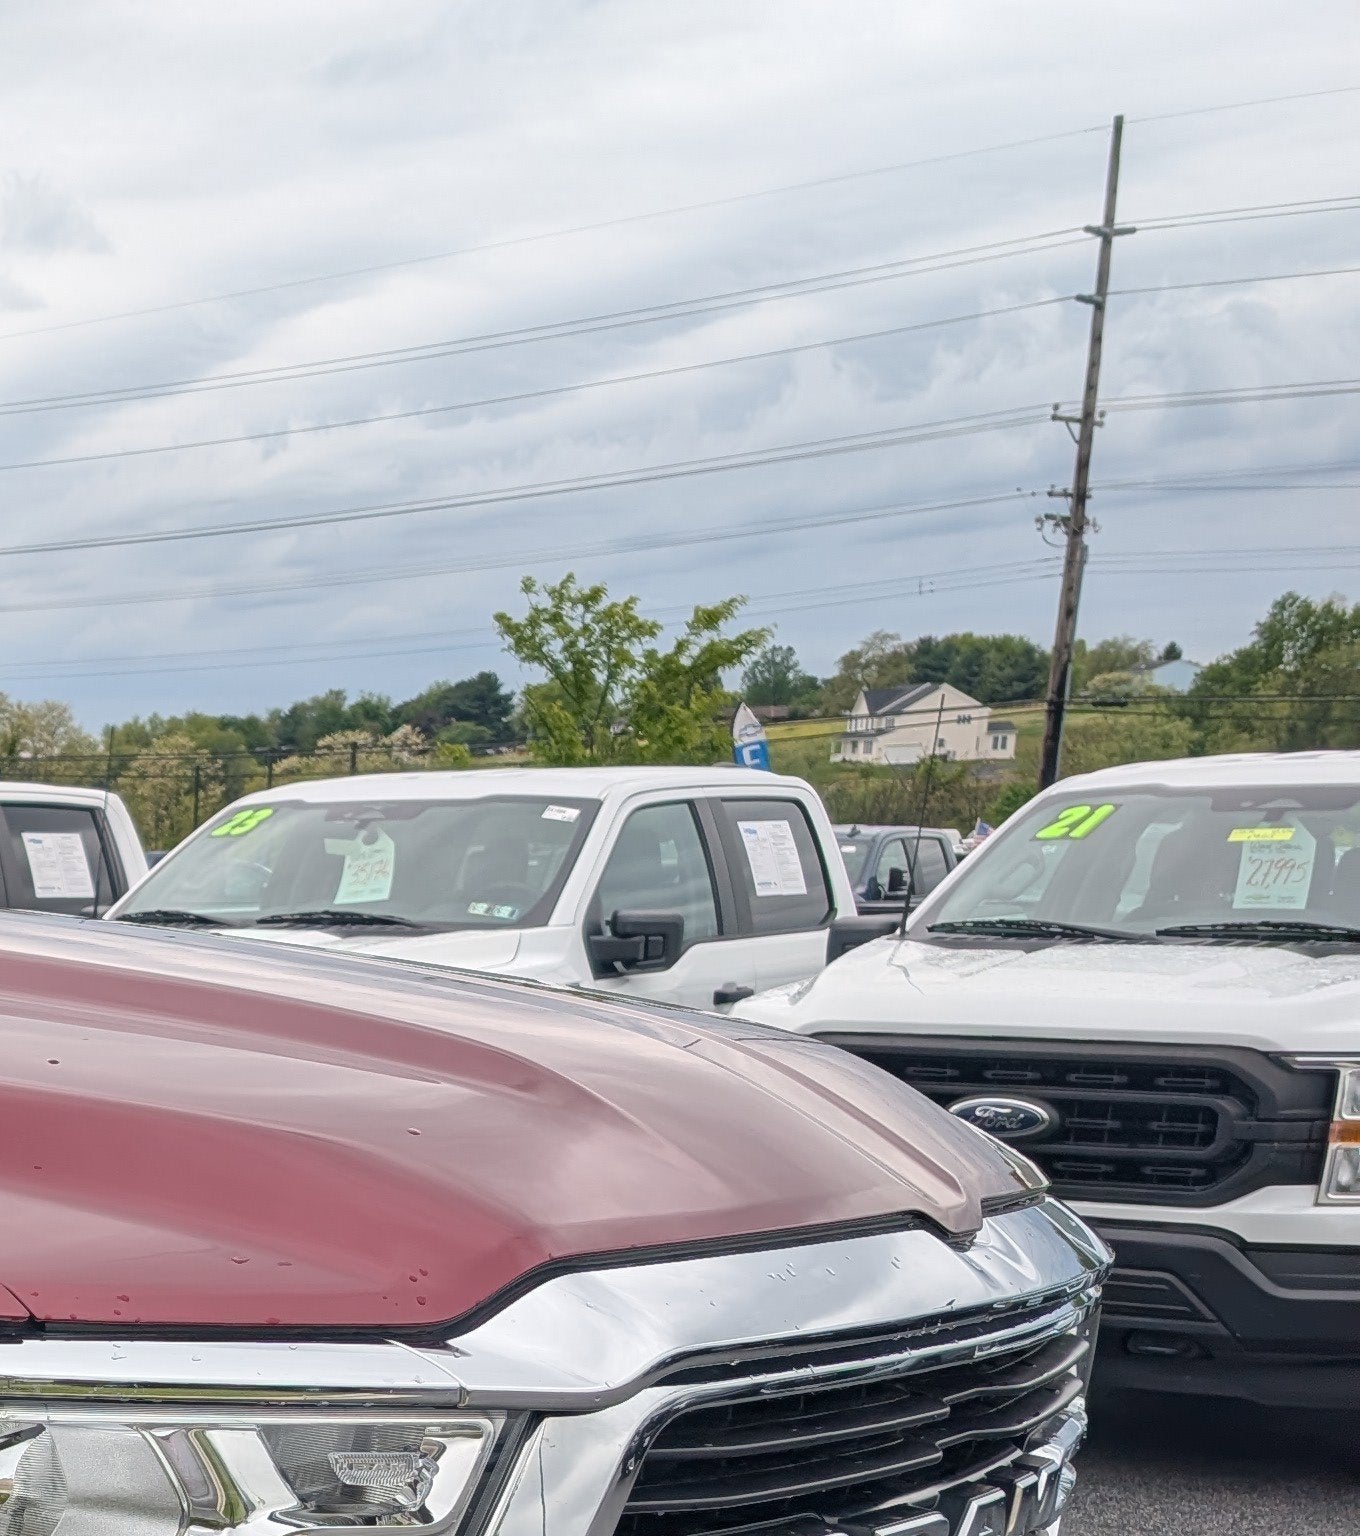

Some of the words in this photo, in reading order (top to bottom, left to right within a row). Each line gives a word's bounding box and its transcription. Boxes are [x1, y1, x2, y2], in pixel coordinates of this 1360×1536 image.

[210, 806, 275, 837] 23
[1034, 803, 1117, 840] 21
[968, 1105, 1026, 1129] Ford
